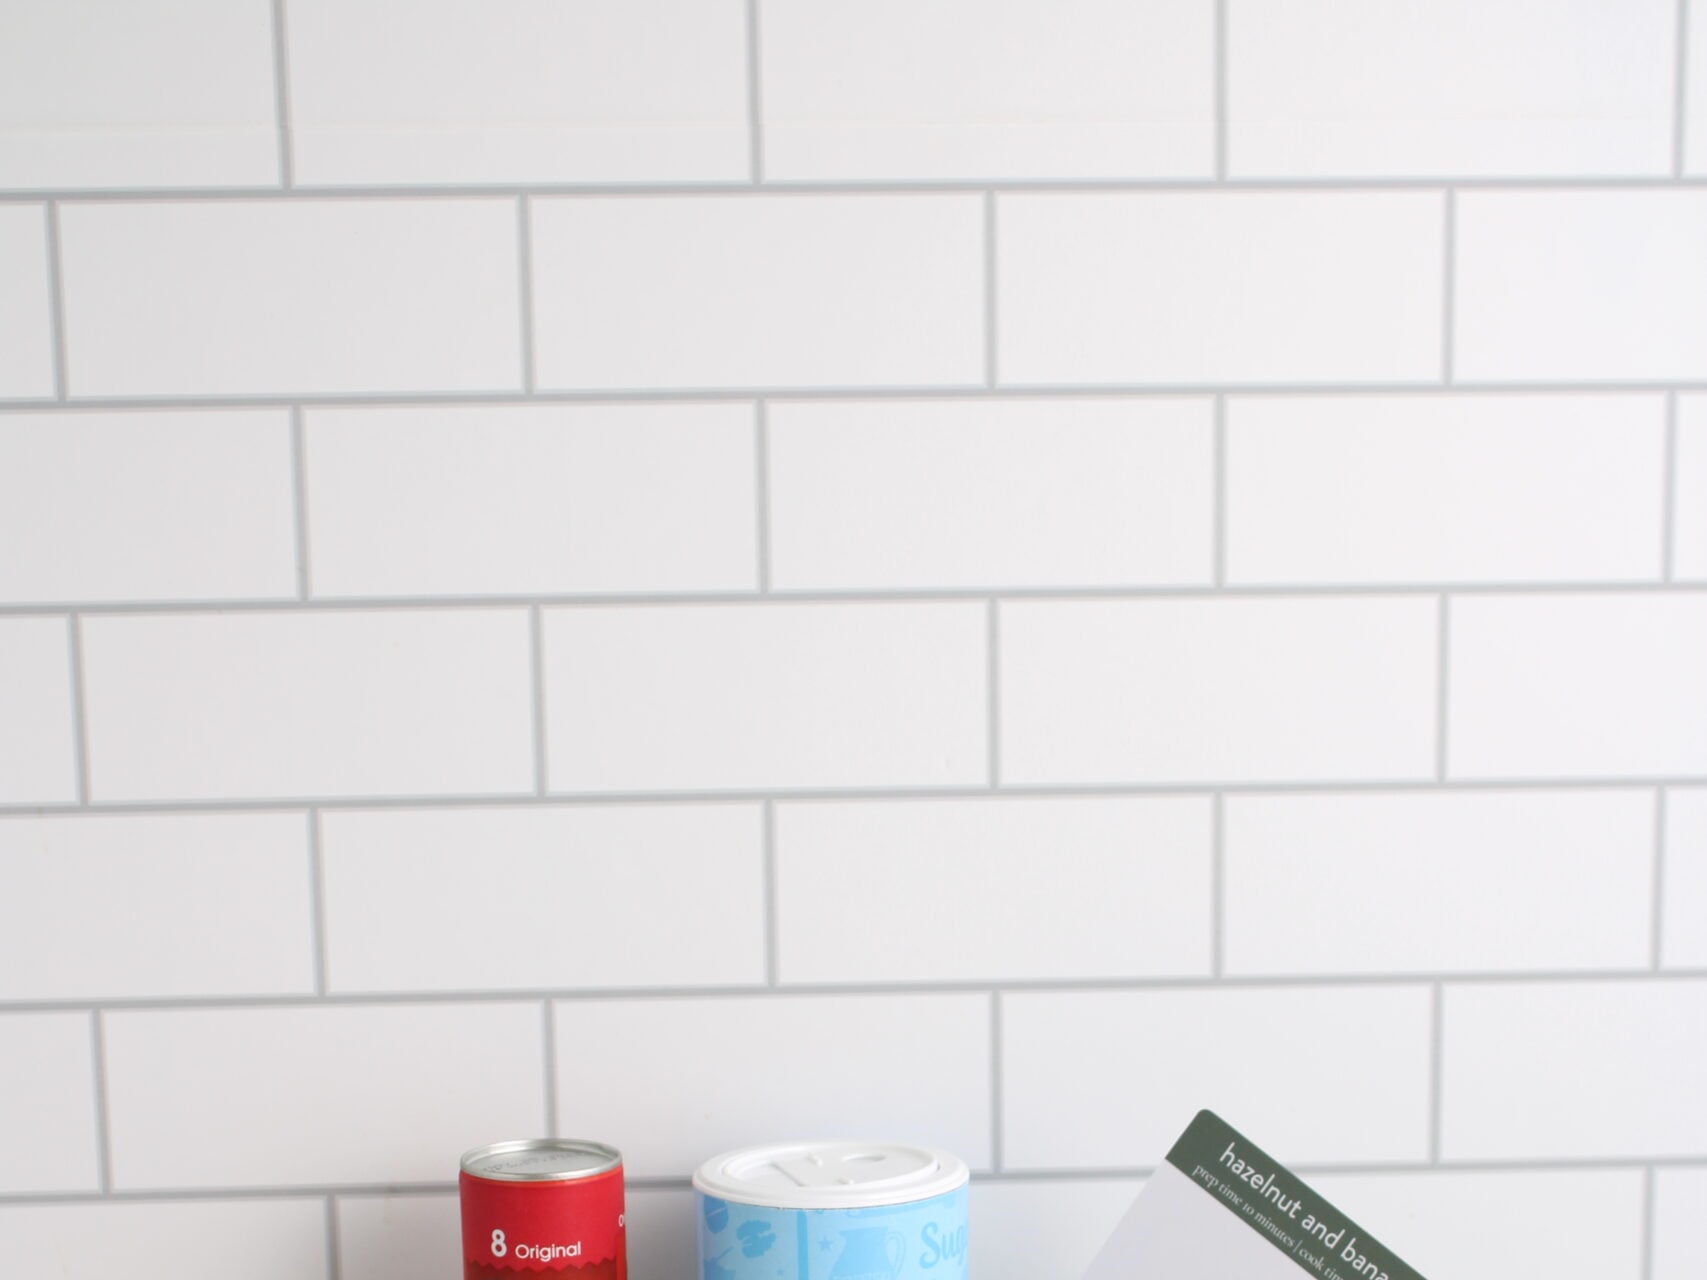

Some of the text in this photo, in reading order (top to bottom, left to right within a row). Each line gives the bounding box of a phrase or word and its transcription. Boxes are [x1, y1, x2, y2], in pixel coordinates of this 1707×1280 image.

[491, 1228, 581, 1263] 8 Original
[1191, 1165, 1219, 1189] prep
[1218, 1185, 1244, 1207] time
[1241, 1202, 1255, 1216] 10
[1254, 1211, 1295, 1248] minutes
[1298, 1245, 1325, 1272] cook
[1218, 1141, 1302, 1219] hazelnut
[1301, 1214, 1346, 1250] and
